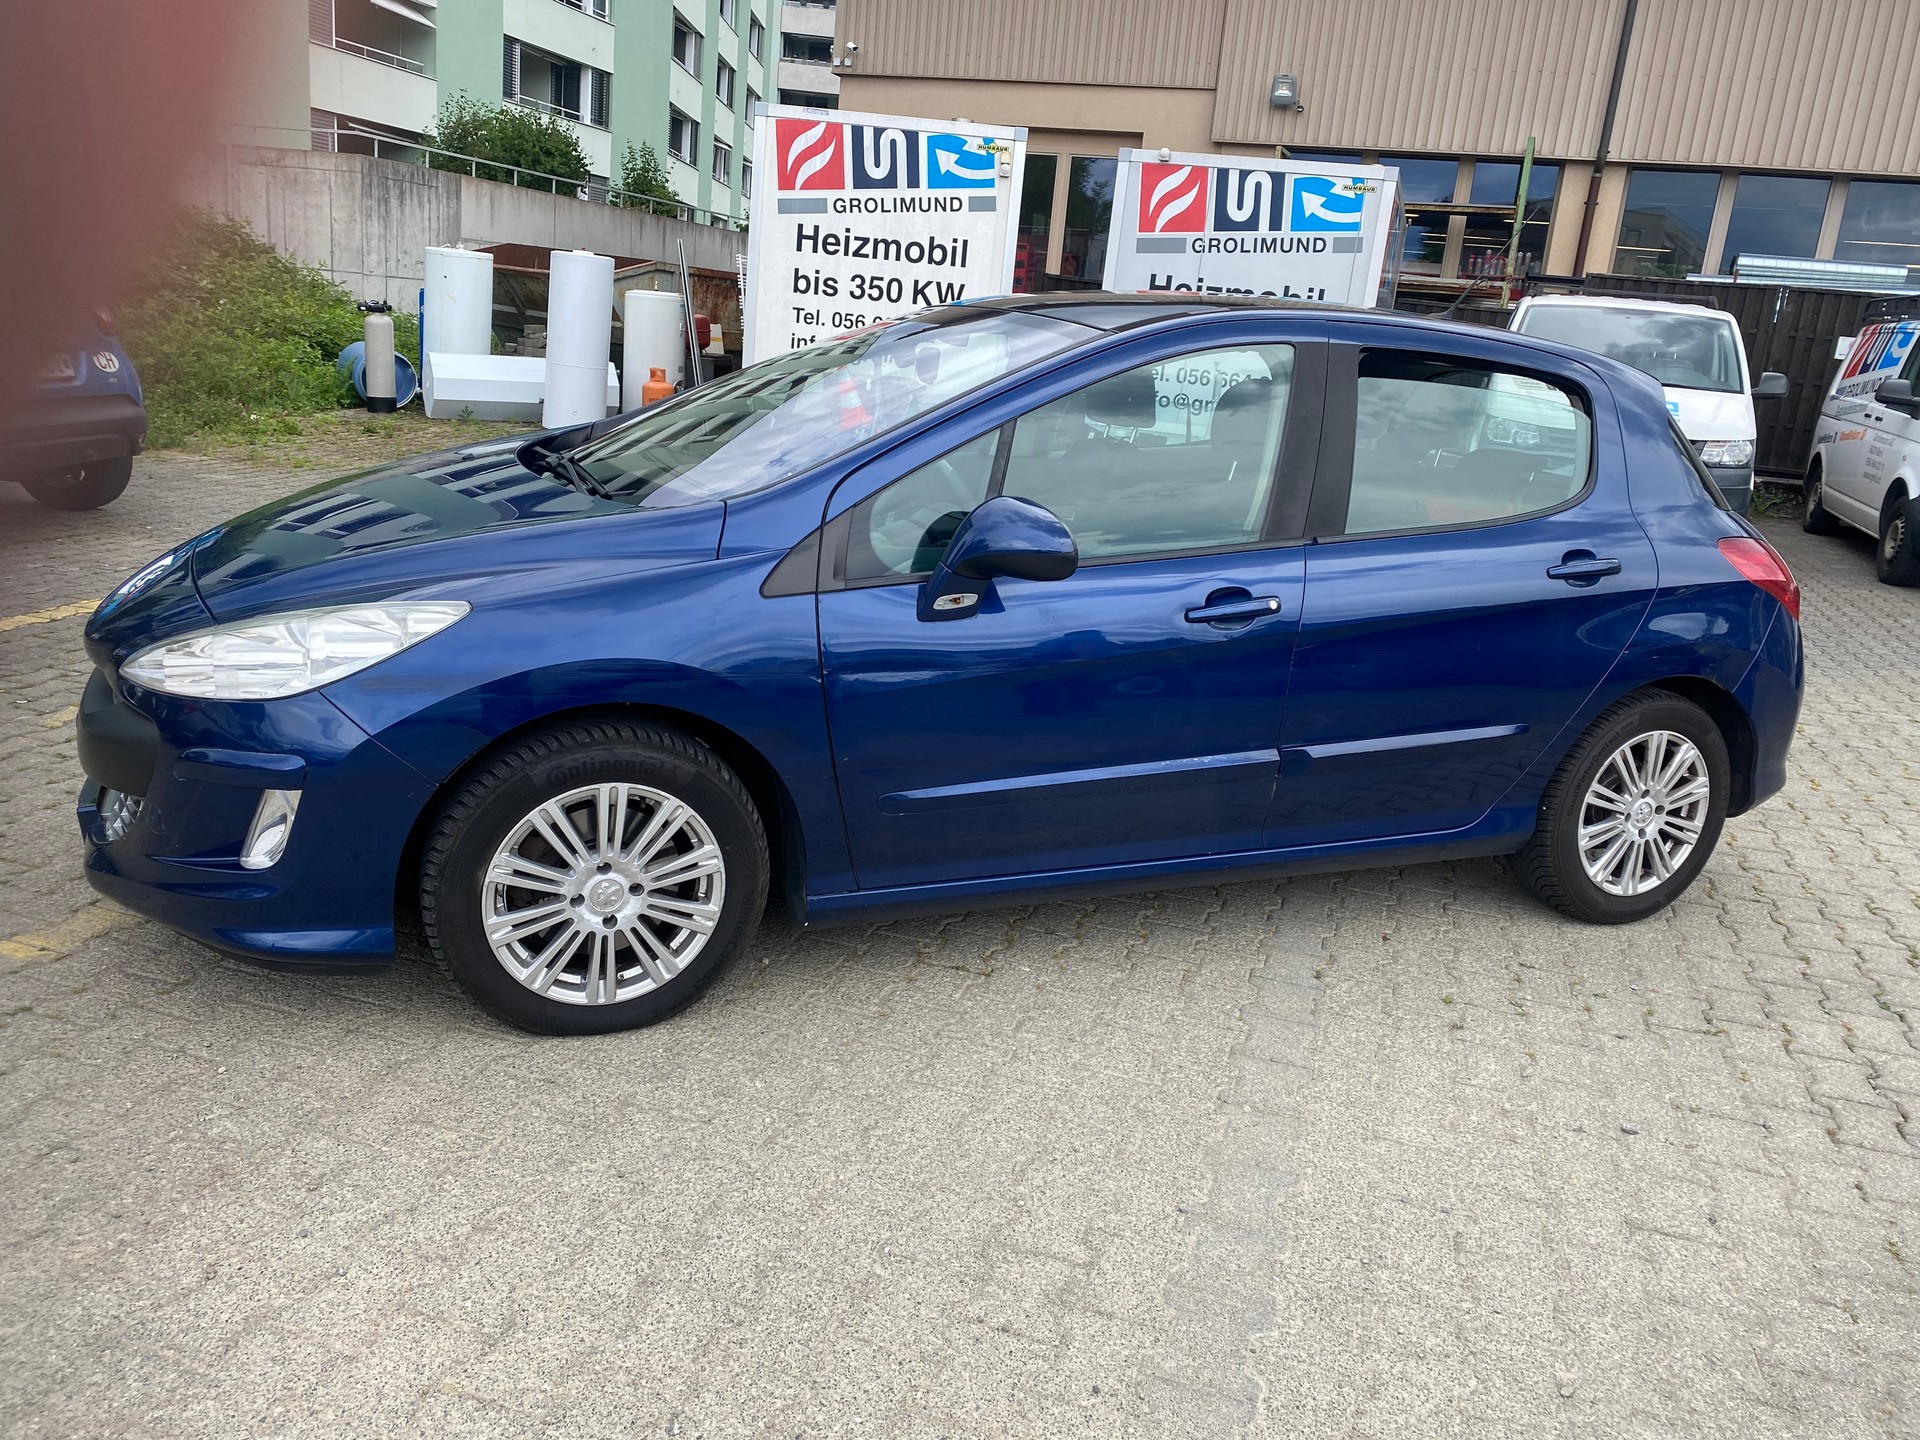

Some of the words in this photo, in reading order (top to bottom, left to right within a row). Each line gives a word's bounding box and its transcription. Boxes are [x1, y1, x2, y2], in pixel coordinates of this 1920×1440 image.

[833, 197, 963, 214] GROLIMUND
[795, 223, 969, 268] Heizmobil
[1191, 237, 1327, 254] GROLIMUND
[793, 268, 839, 297] bis
[849, 274, 903, 303] 350
[912, 279, 966, 307] KW
[792, 307, 825, 326] Tel.
[832, 312, 866, 330] 056
[97, 352, 117, 370] CH
[1176, 367, 1211, 386] 056
[548, 758, 666, 786] Continental
